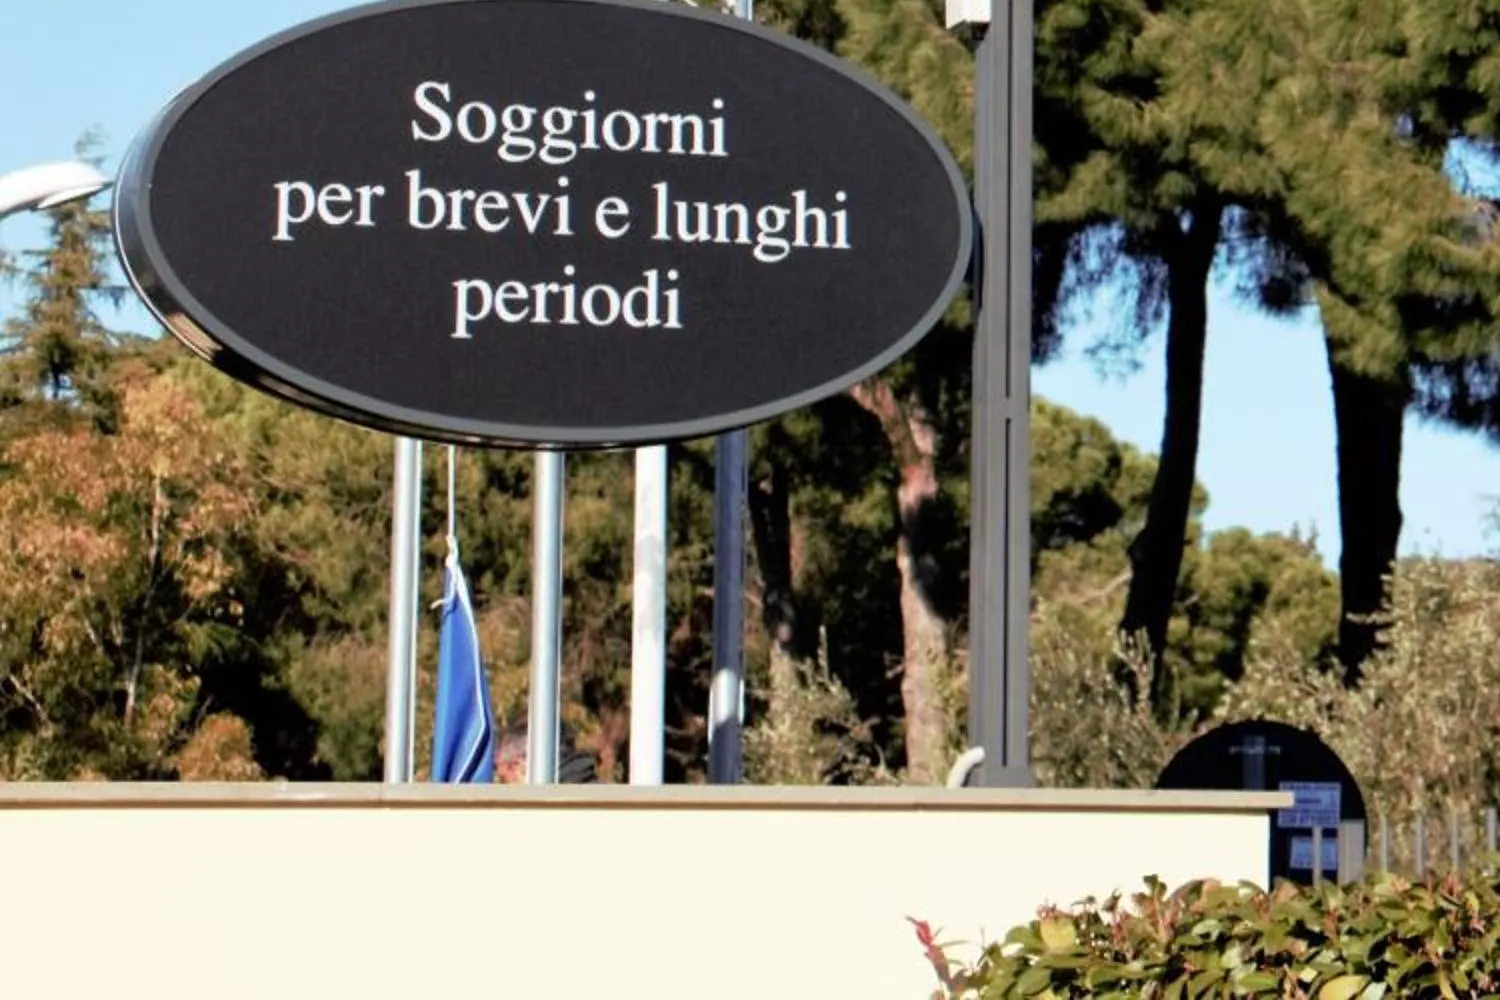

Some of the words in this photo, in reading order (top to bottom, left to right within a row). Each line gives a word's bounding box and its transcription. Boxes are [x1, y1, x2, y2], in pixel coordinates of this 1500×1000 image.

[411, 81, 729, 165] Soggiorni
[271, 181, 386, 241] per
[404, 168, 574, 236] brevi
[595, 196, 630, 239] e
[651, 181, 852, 263] lunghi
[451, 264, 683, 339] periodi
